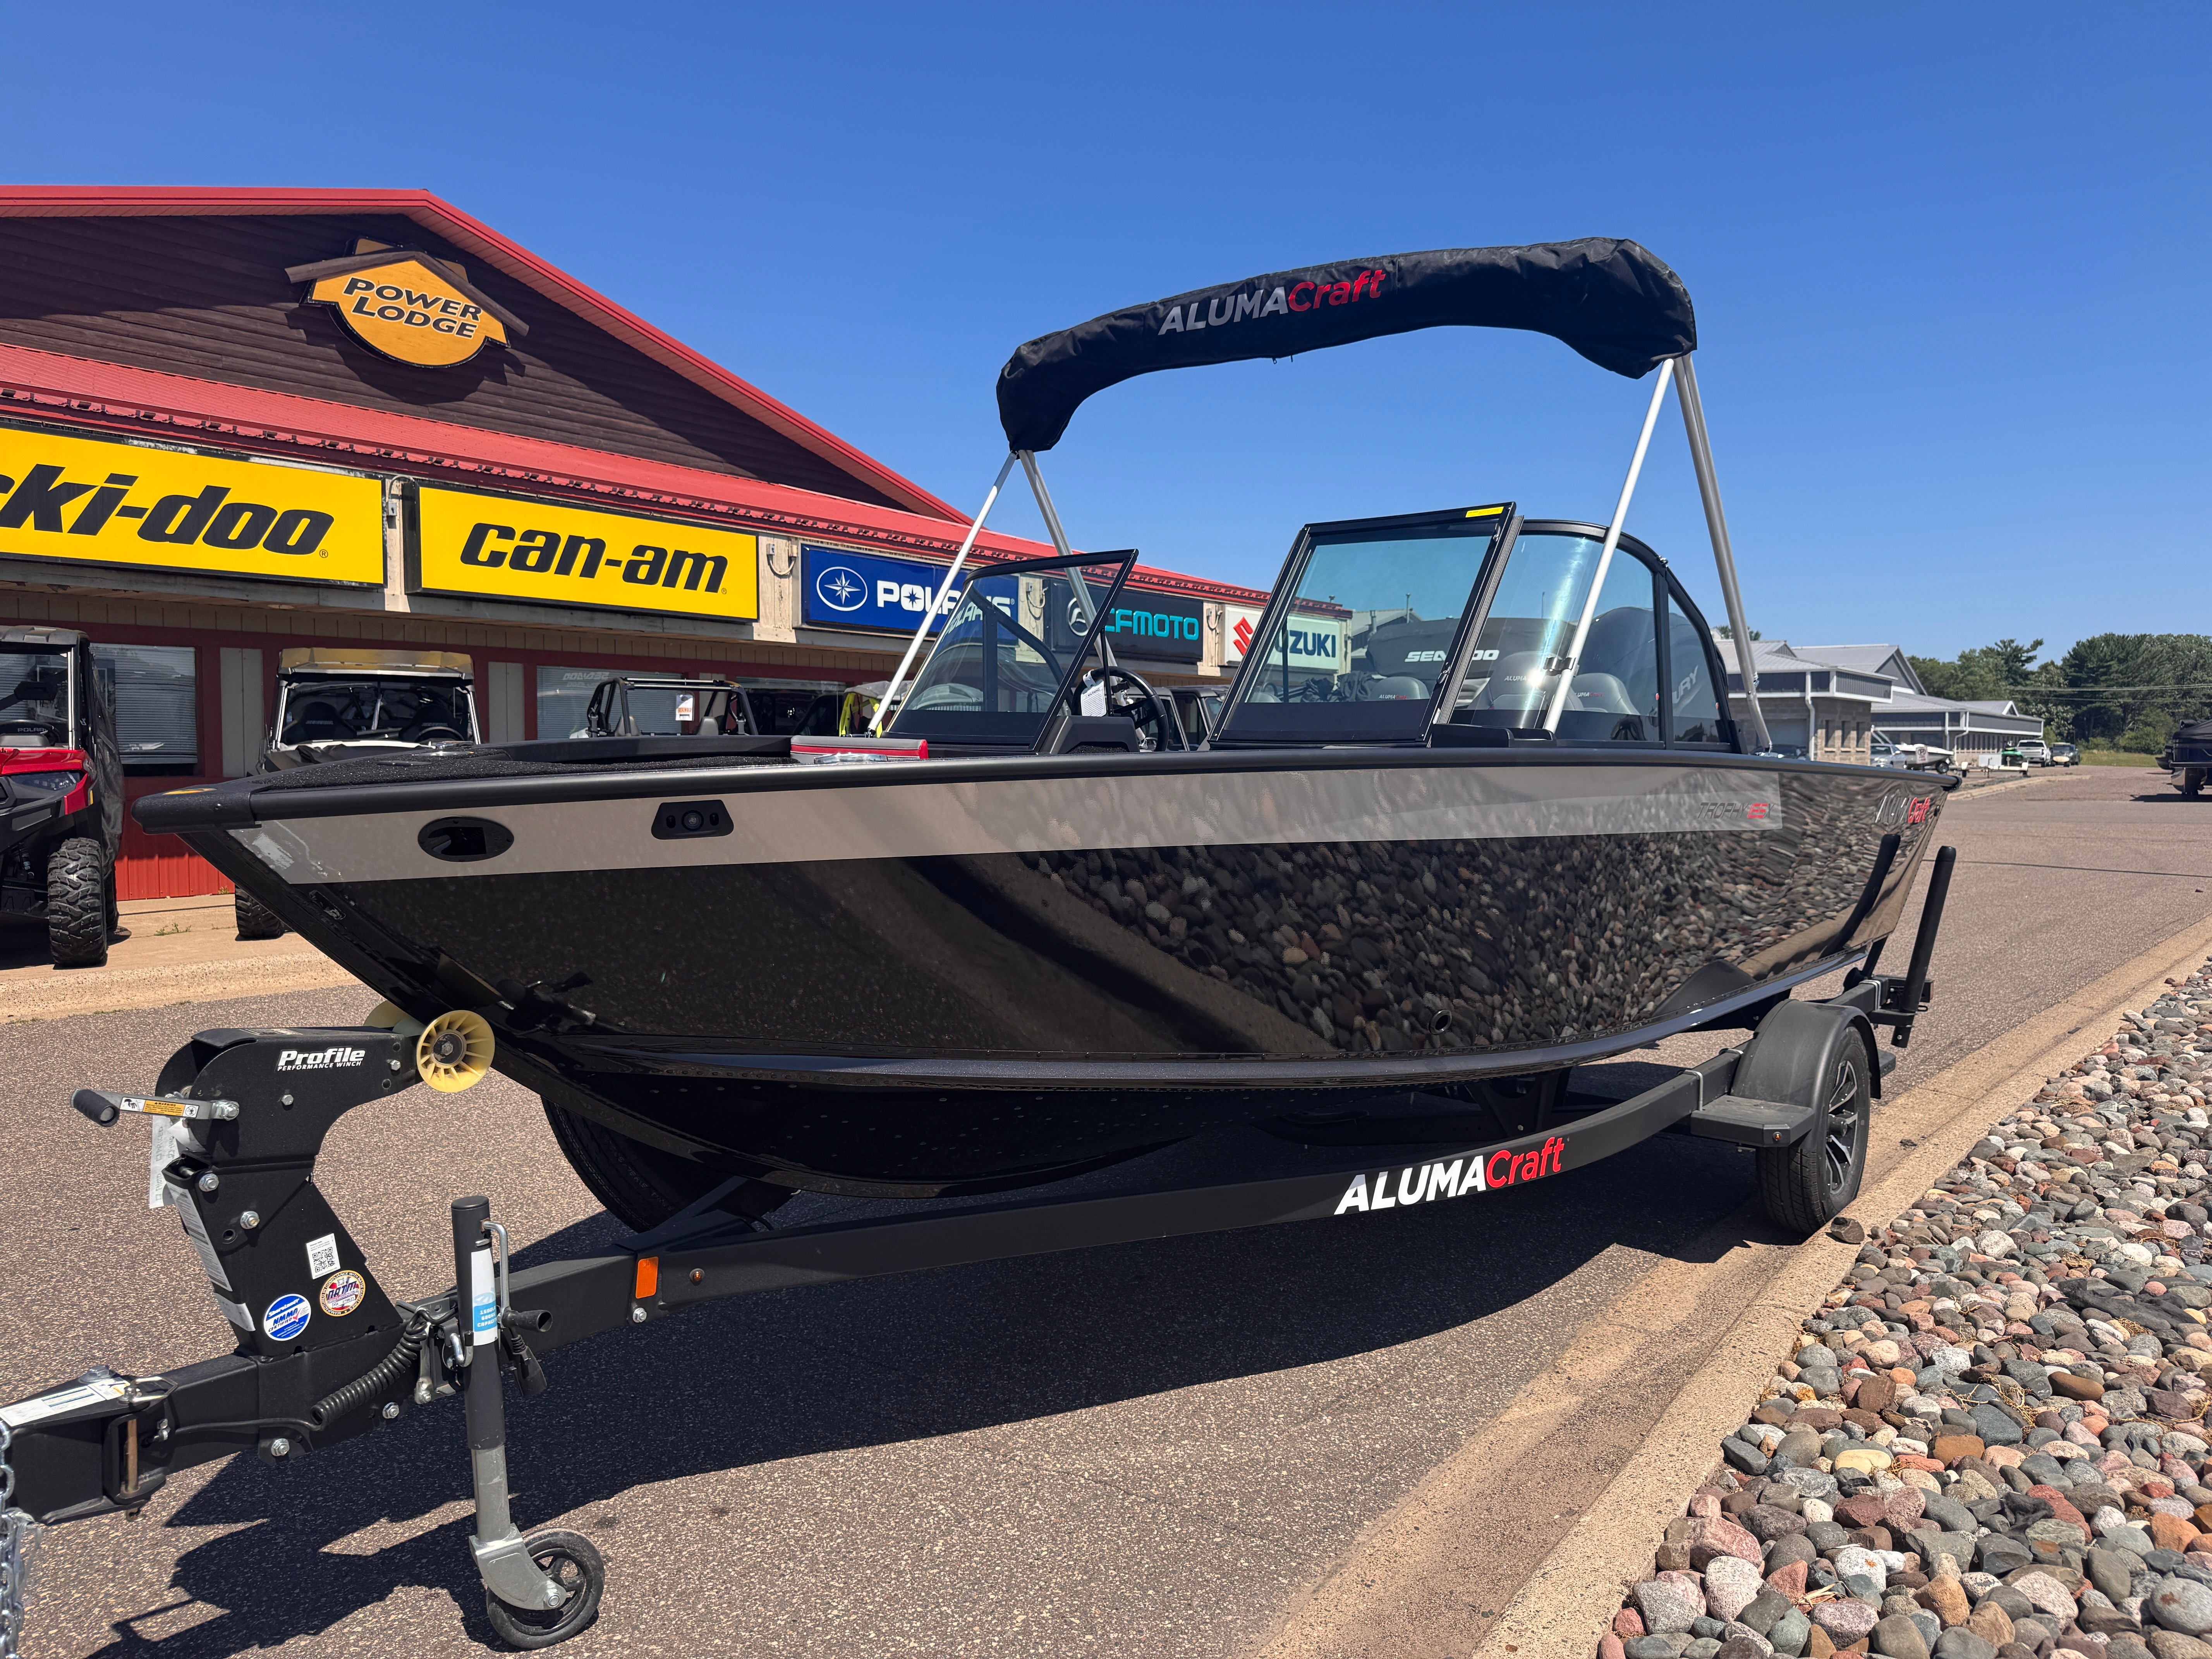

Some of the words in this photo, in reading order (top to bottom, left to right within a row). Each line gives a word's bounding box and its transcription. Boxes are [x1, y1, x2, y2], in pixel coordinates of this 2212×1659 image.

[343, 277, 482, 322] POWER
[352, 296, 477, 339] LODGE
[1158, 270, 1386, 335] ALUMACraft
[460, 523, 728, 593] can-am
[277, 1062, 334, 1072] PERFORMANCE
[278, 1047, 366, 1066] Profile
[1334, 1136, 1565, 1215] ALUMACraft
[268, 1317, 292, 1332] CERTIFIED
[273, 1308, 298, 1326] NMMA
